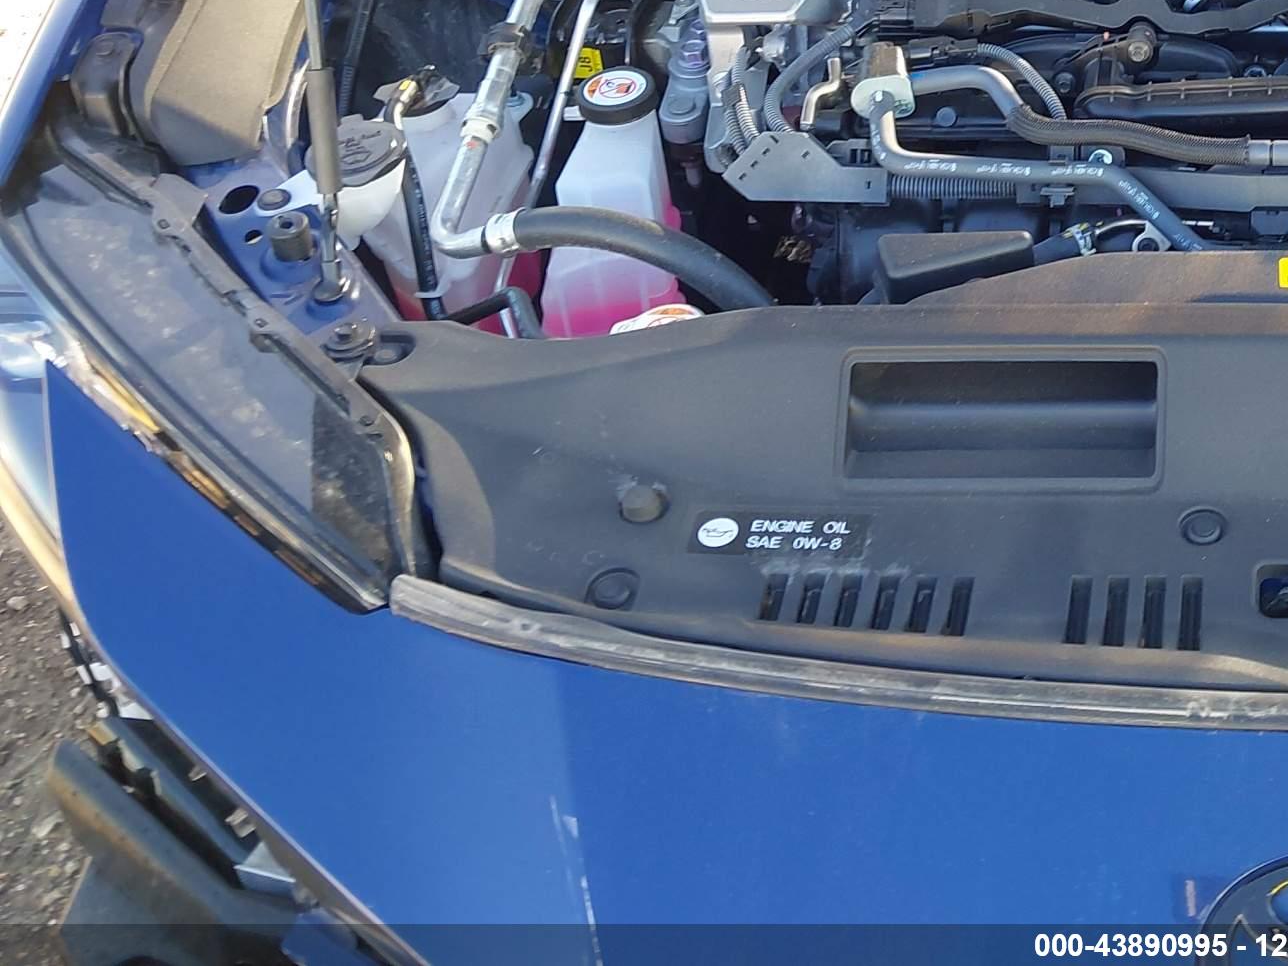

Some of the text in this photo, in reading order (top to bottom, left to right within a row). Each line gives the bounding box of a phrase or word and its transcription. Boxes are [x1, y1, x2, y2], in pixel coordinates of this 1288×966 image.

[750, 519, 851, 534] ENGINE OIL
[745, 535, 843, 550] SAE 0W-8
